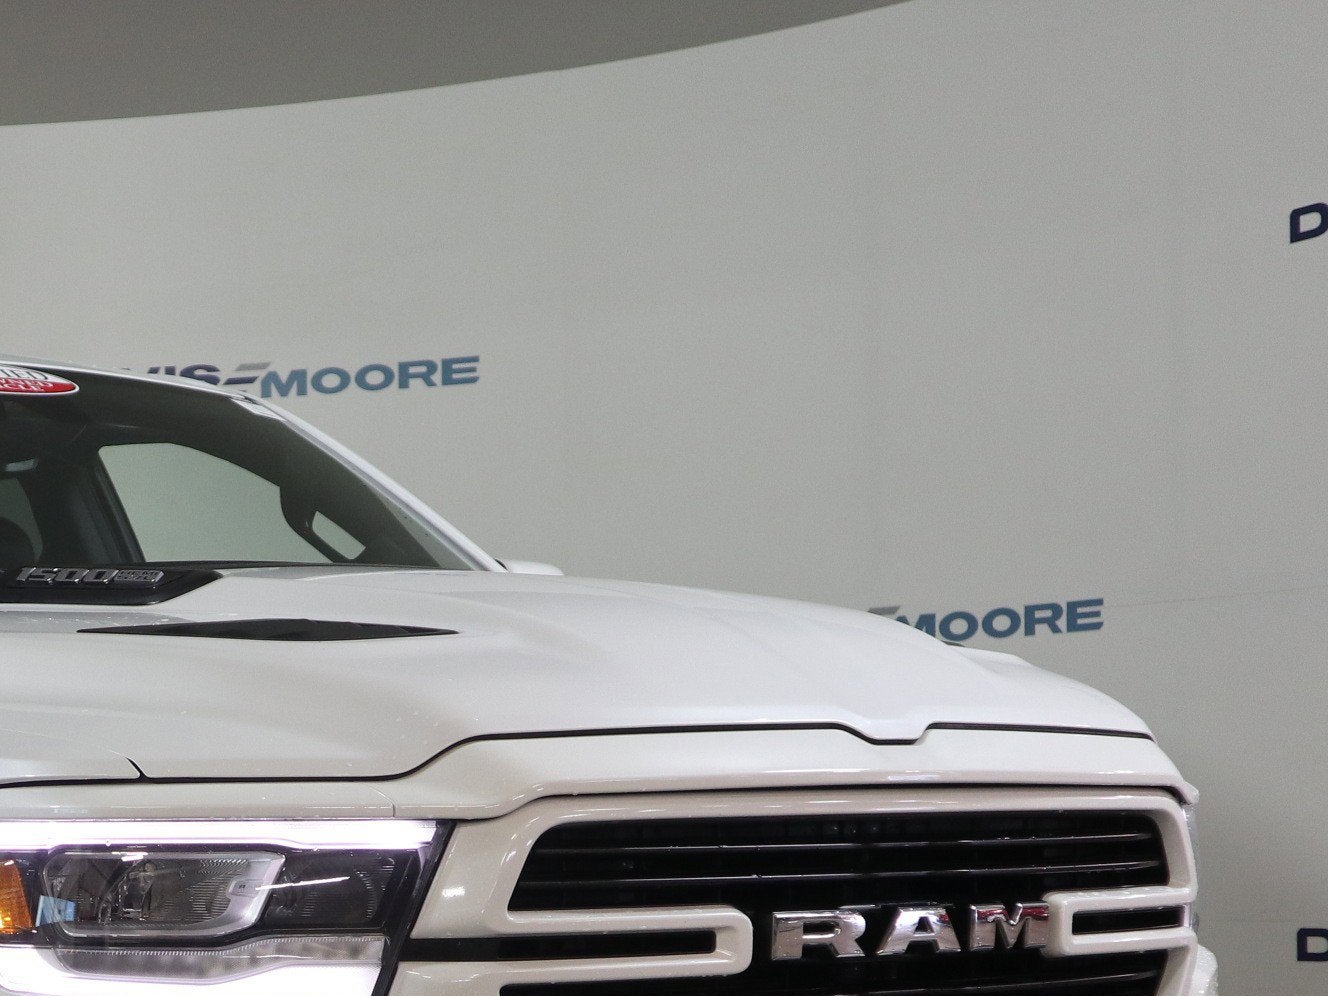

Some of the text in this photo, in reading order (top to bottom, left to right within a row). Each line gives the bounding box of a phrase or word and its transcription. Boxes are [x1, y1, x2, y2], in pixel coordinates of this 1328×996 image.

[260, 355, 480, 398] MOORE
[16, 567, 118, 583] 1500
[772, 903, 1051, 961] RAM
